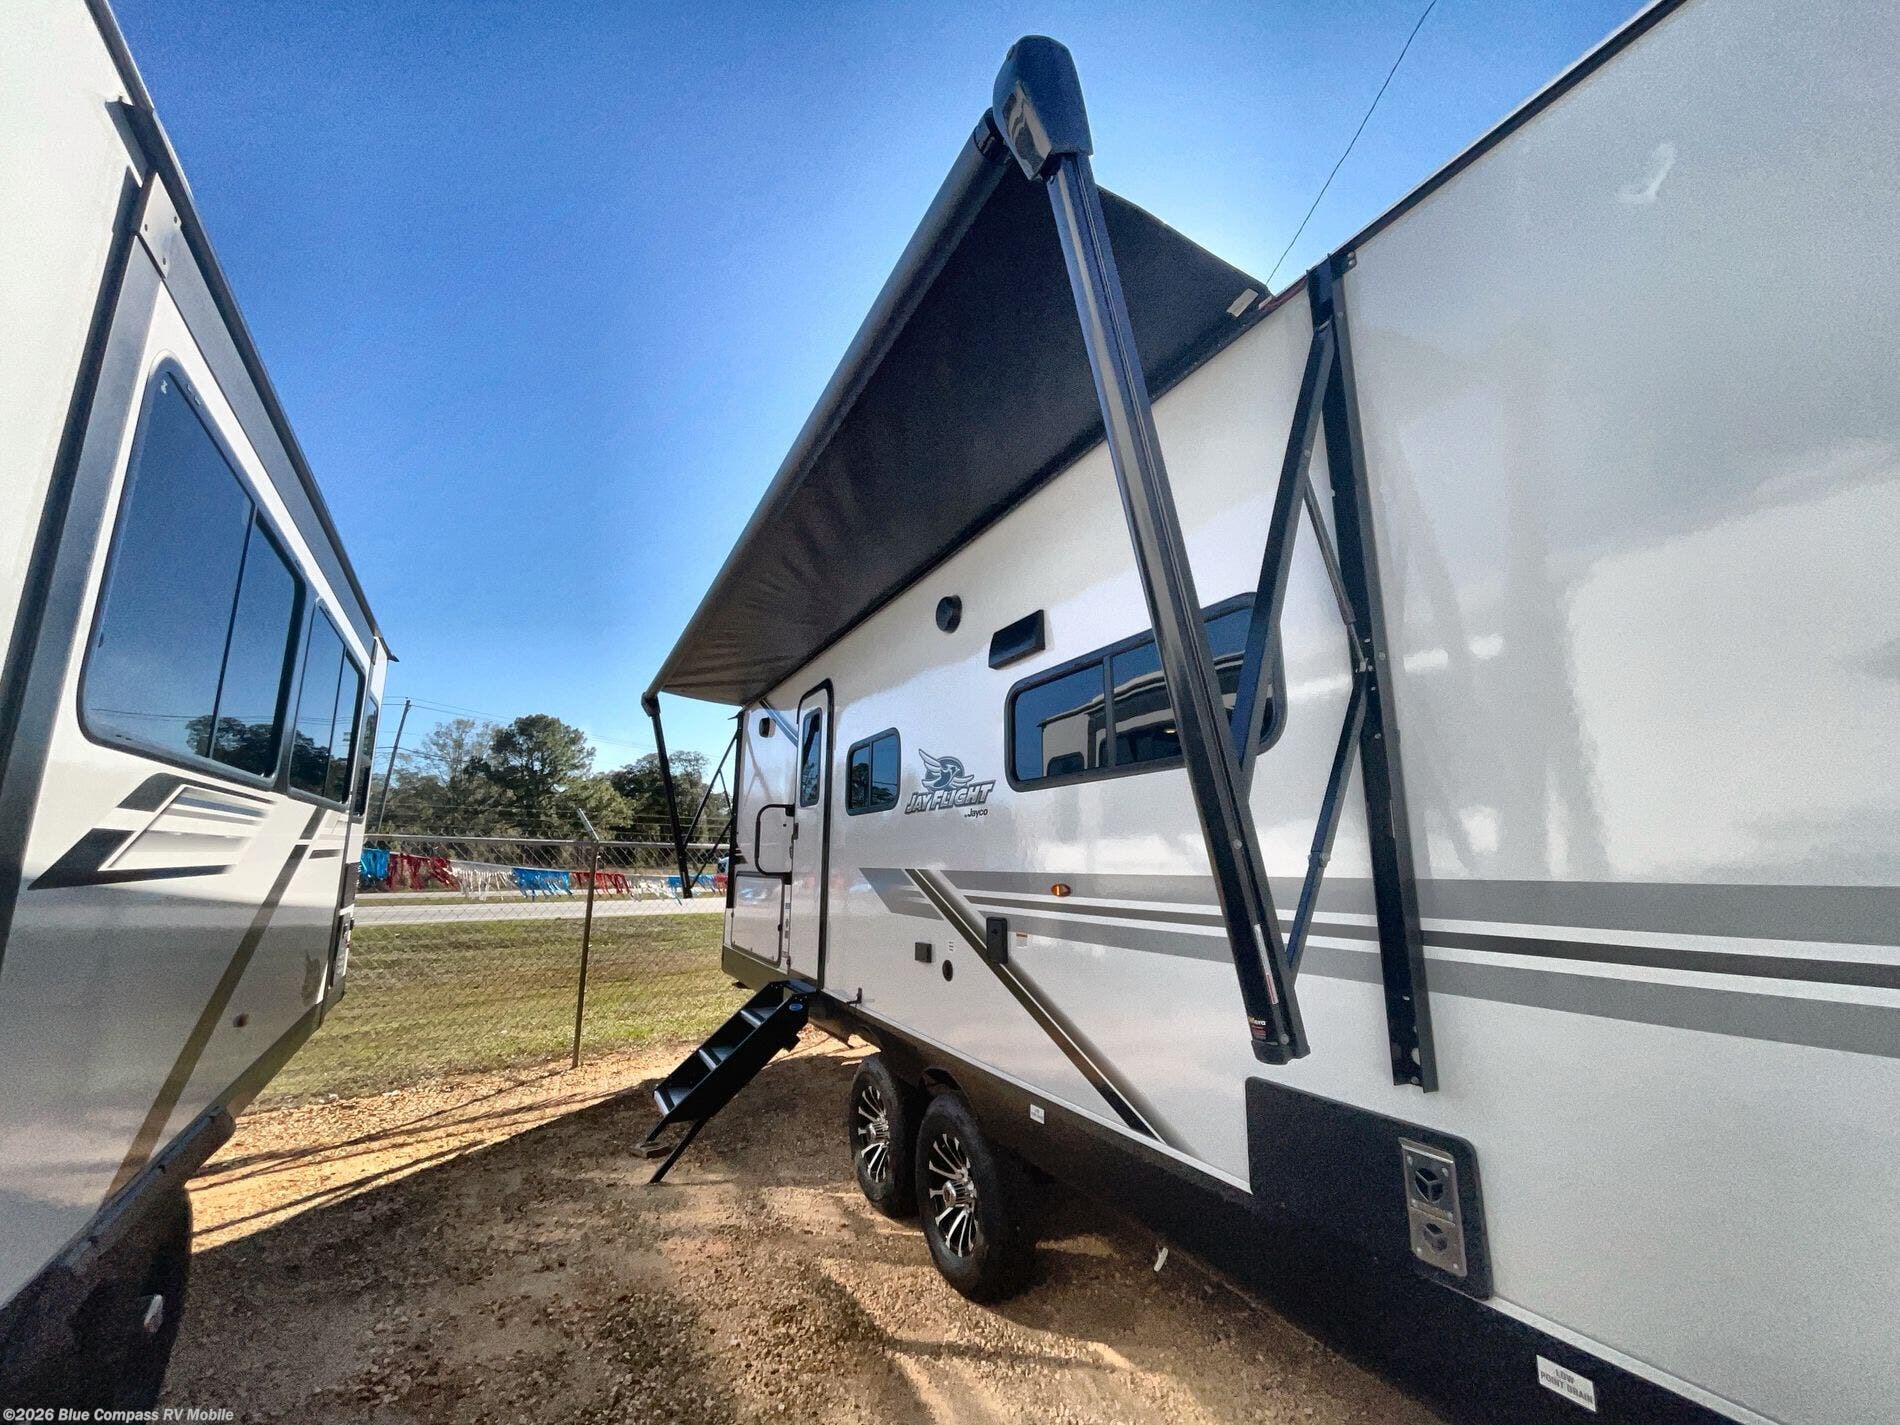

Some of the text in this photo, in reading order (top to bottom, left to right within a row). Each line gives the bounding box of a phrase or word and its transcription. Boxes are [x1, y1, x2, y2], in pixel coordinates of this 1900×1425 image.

[1540, 1370, 1593, 1404] POINT DRAIN
[1555, 1368, 1575, 1385] LOW
